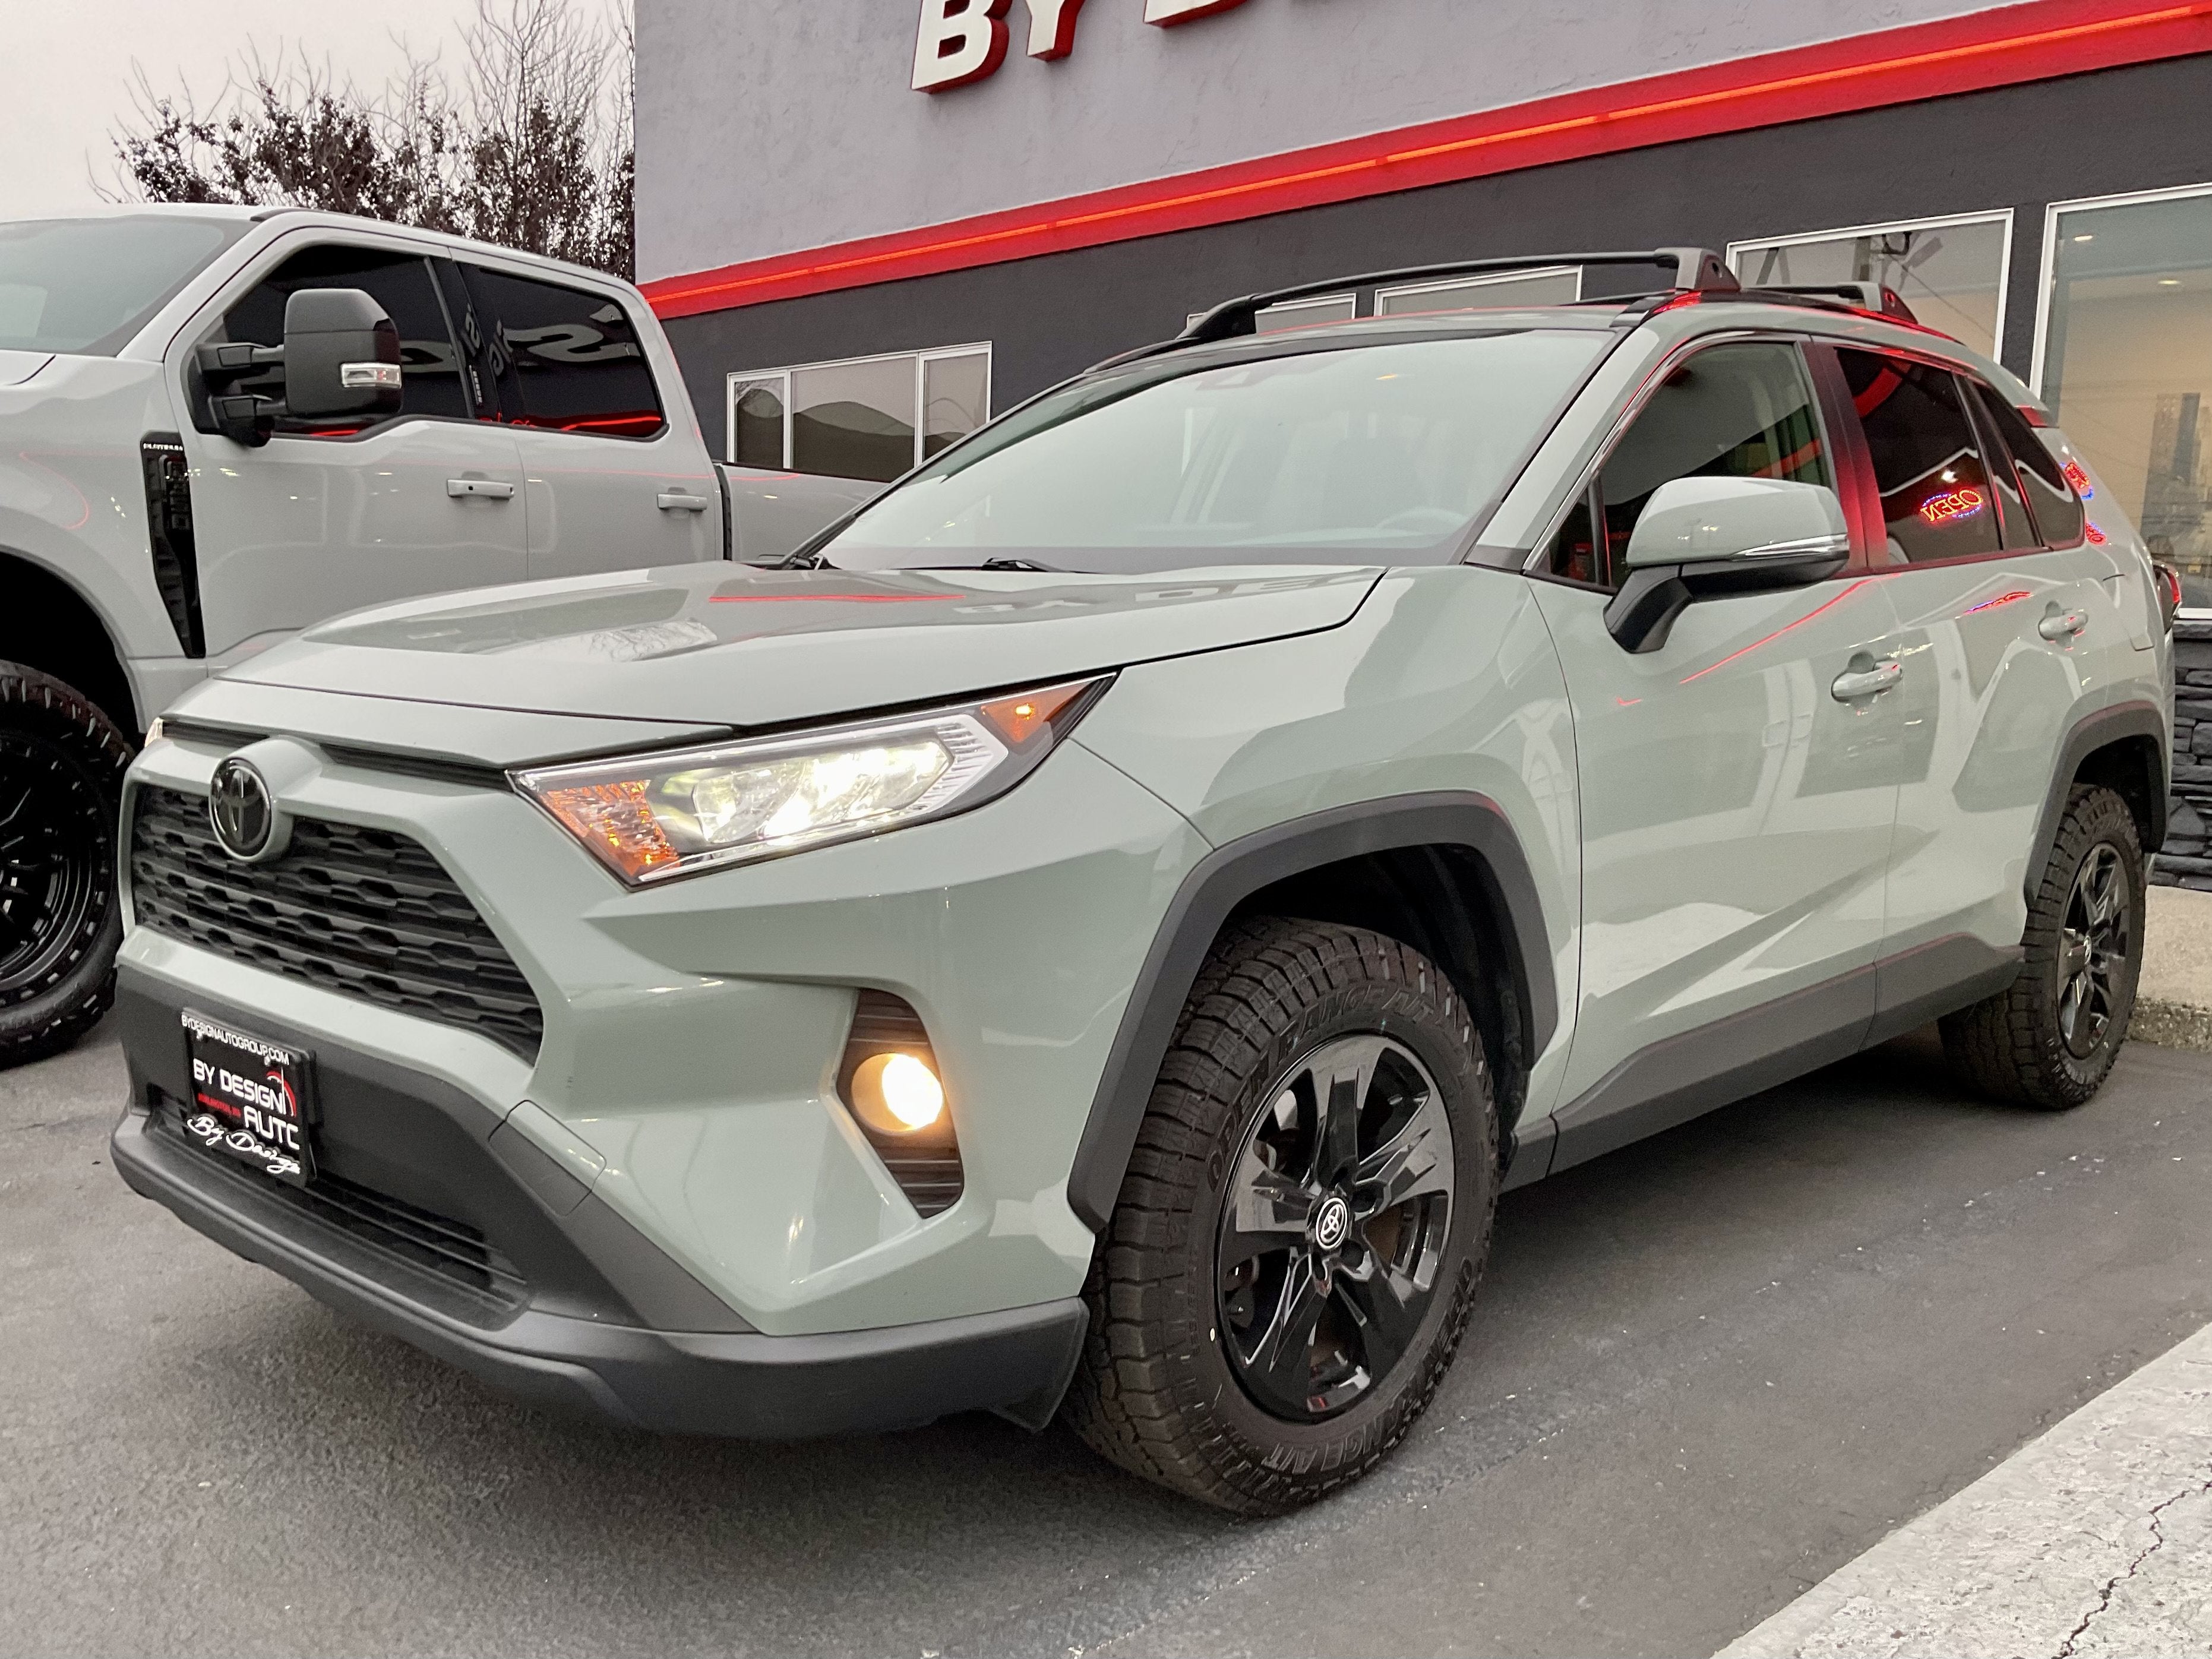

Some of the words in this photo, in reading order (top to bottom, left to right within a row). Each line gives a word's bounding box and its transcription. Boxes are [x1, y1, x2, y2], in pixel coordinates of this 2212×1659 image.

[193, 1058, 215, 1085] BY
[220, 1068, 287, 1115] DESIGN
[187, 1116, 225, 1146] By
